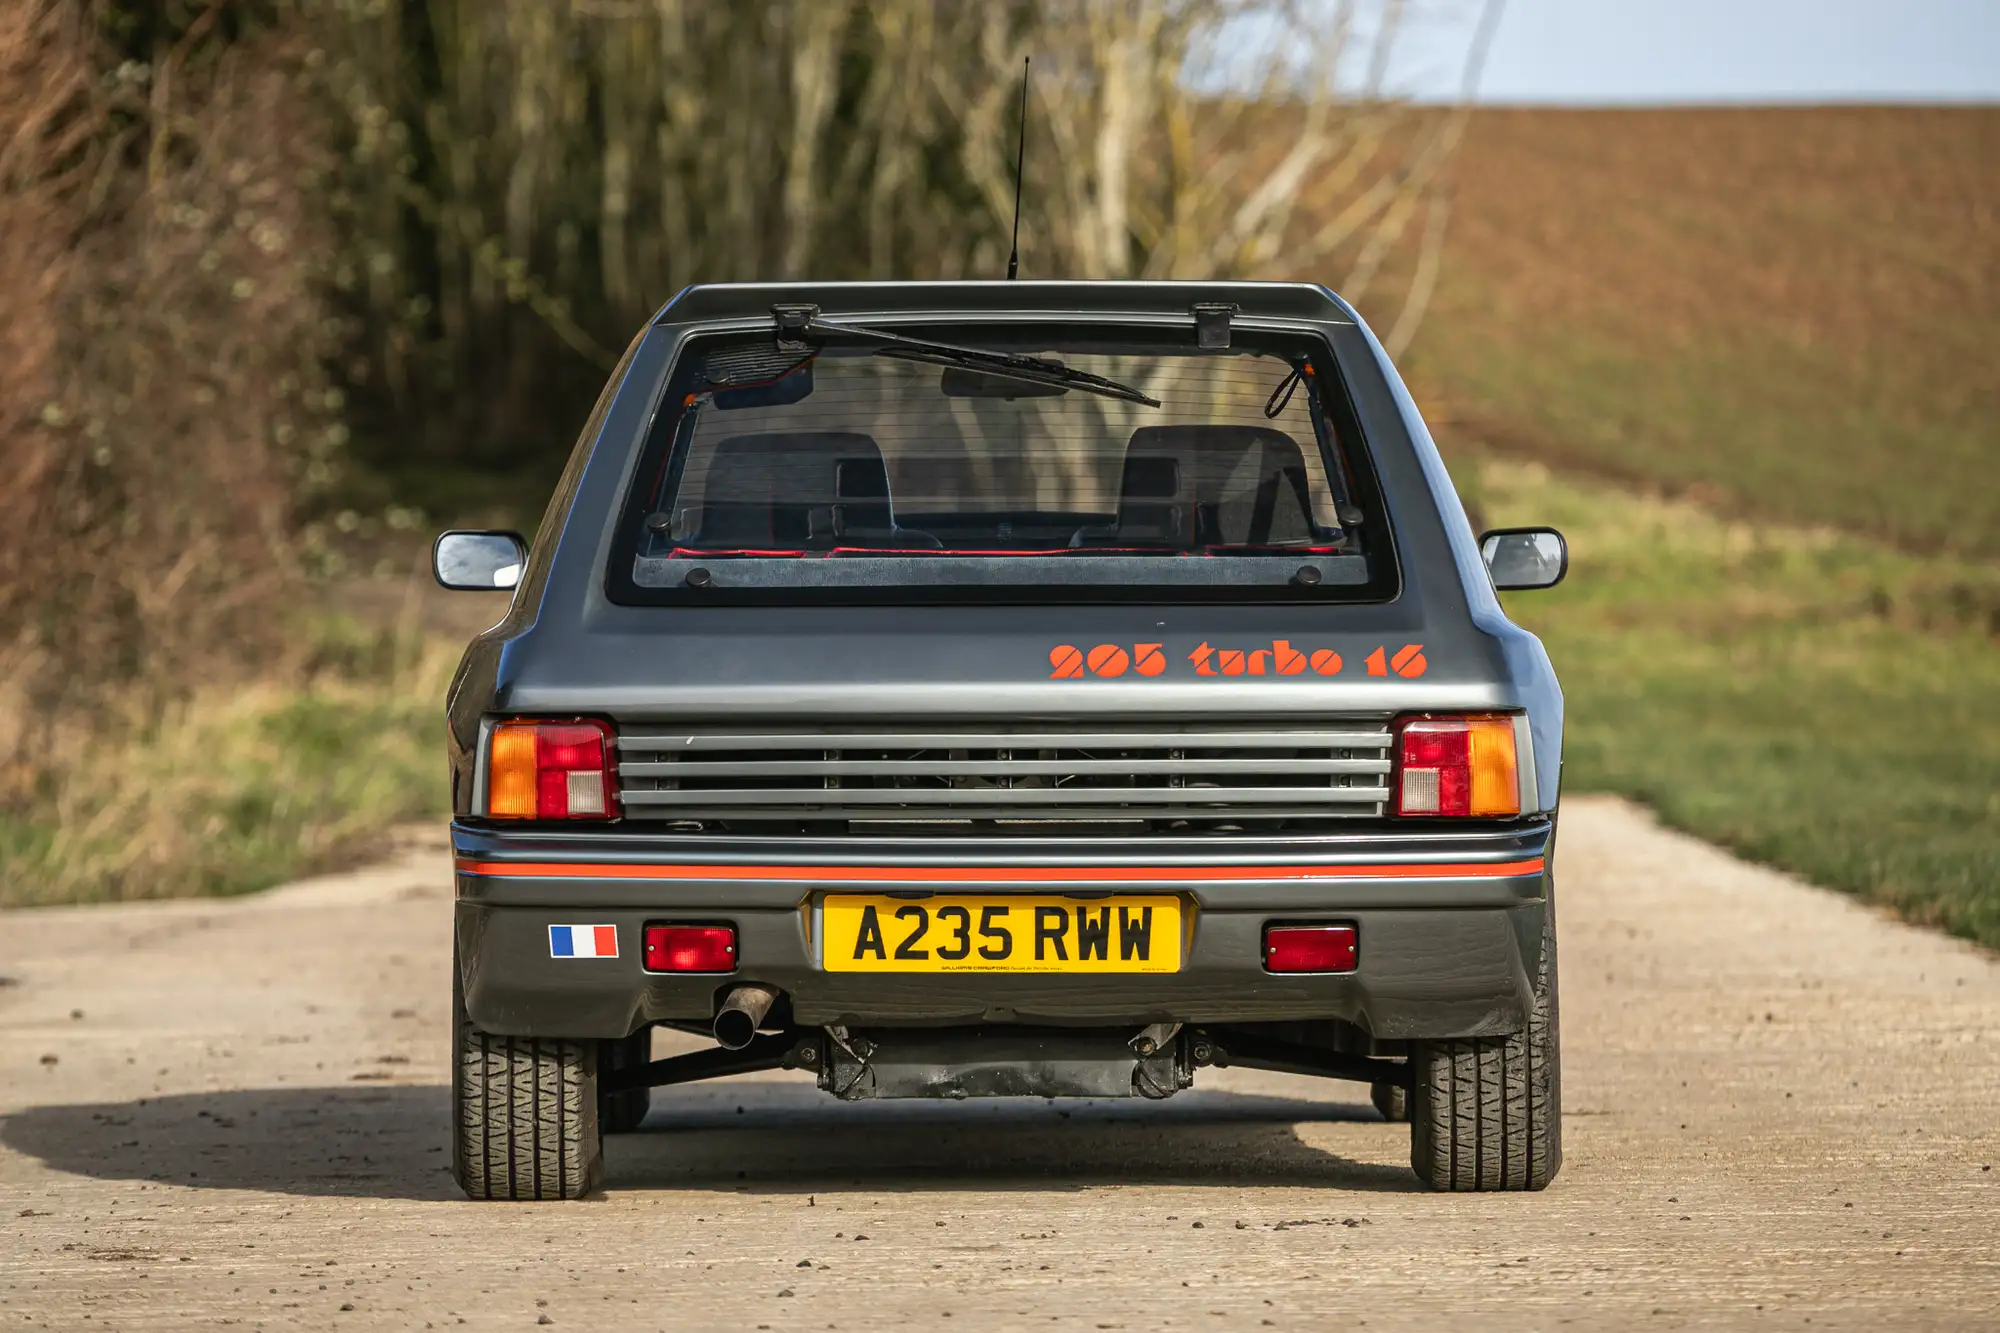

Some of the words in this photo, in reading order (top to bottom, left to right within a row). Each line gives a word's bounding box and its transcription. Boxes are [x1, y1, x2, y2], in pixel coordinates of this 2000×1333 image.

[1049, 643, 1167, 679] 205
[1187, 639, 1343, 676] turbo
[1363, 644, 1428, 678] 16
[853, 905, 1013, 961] A235
[1034, 905, 1153, 961] RWW
